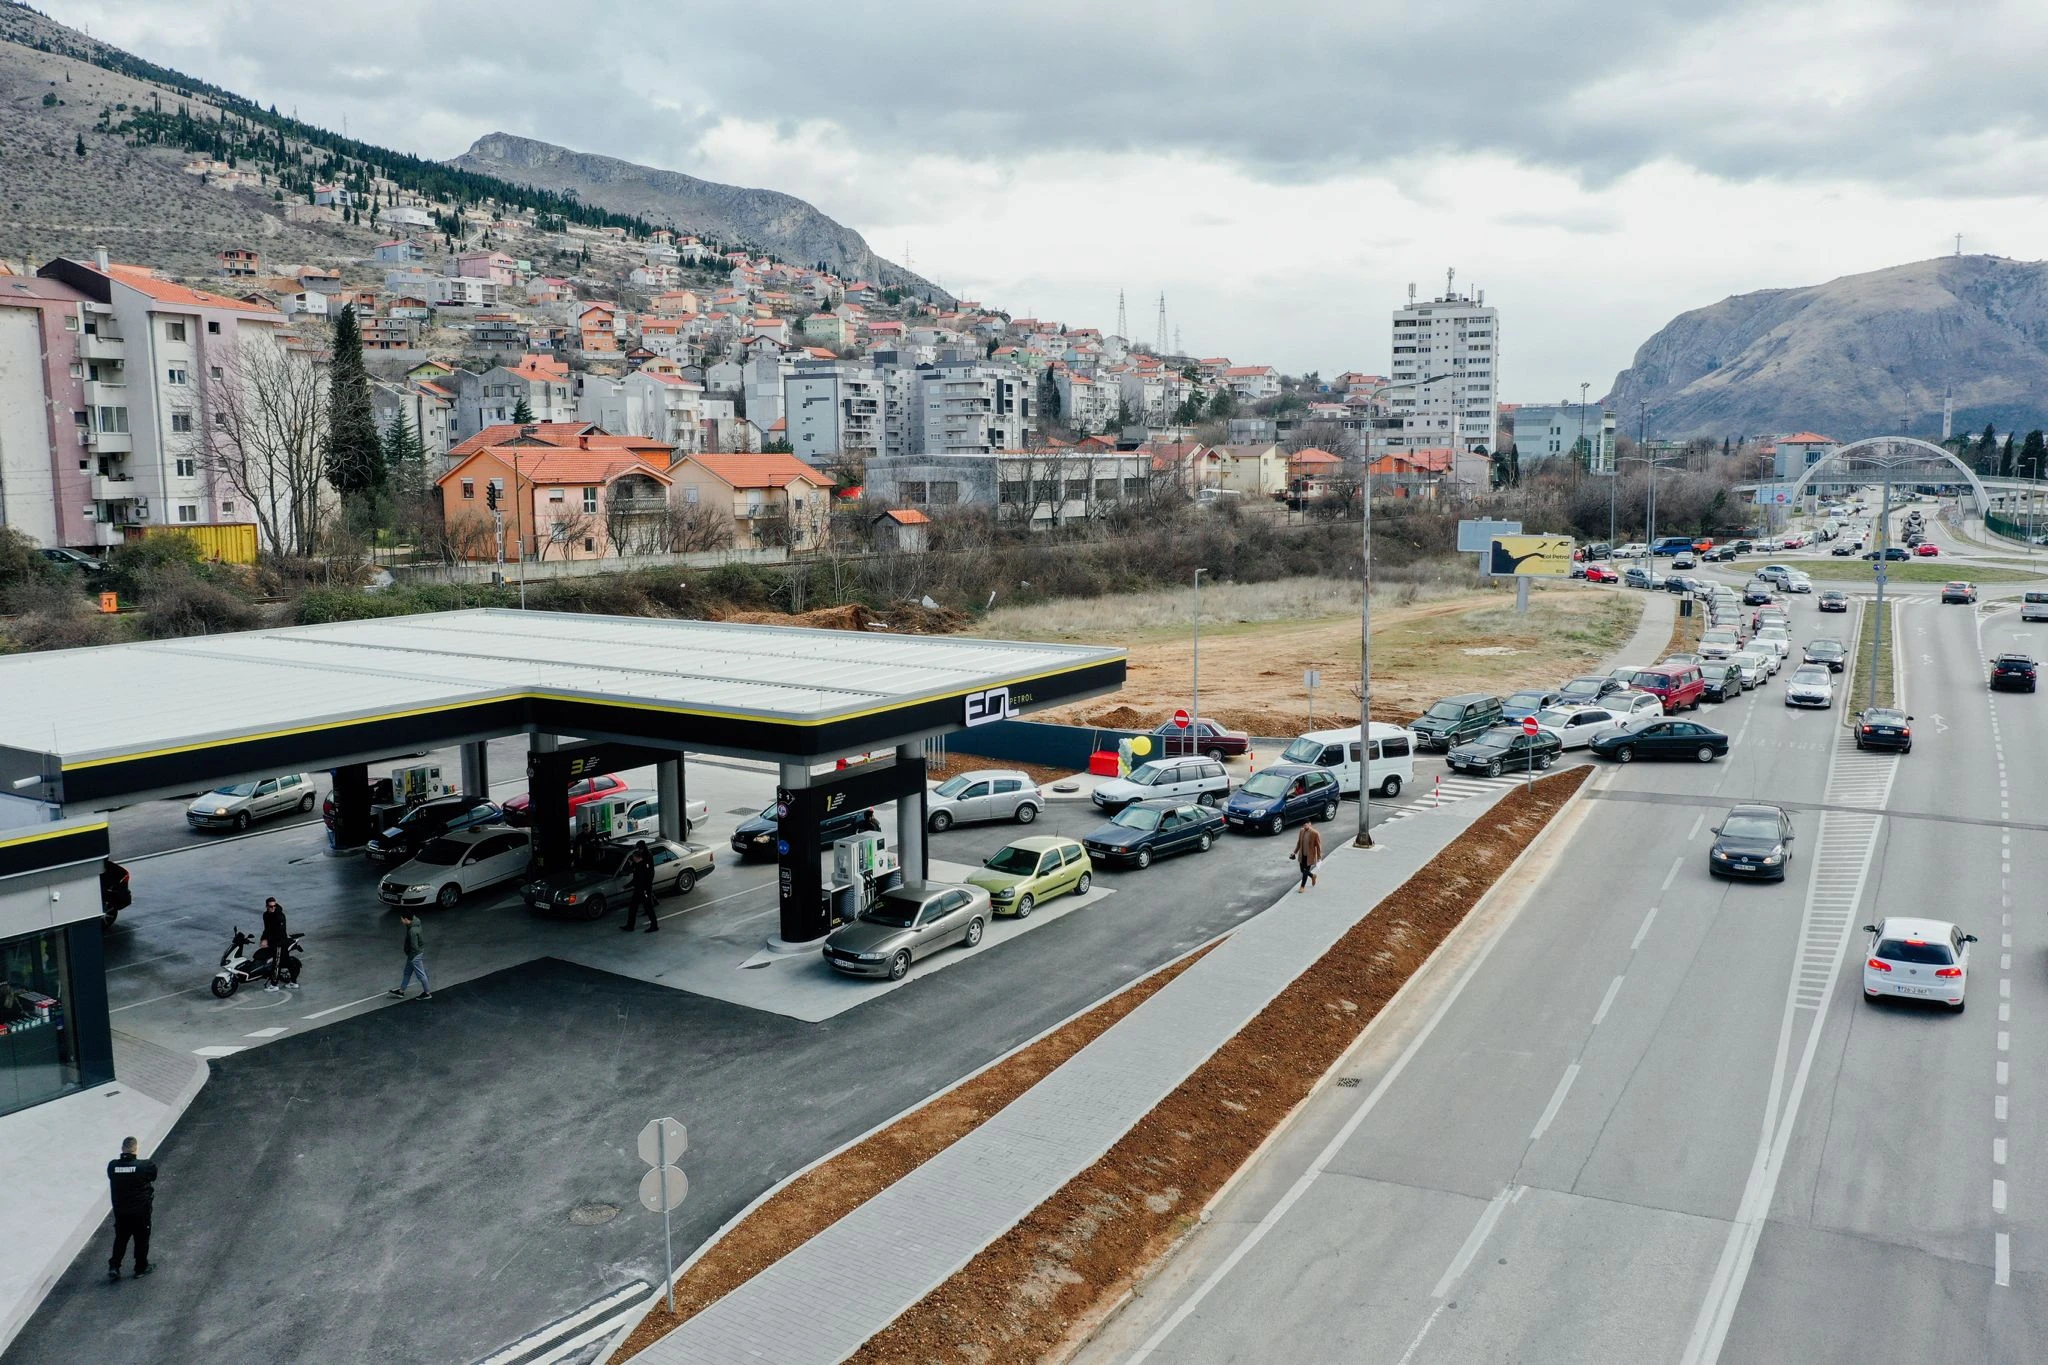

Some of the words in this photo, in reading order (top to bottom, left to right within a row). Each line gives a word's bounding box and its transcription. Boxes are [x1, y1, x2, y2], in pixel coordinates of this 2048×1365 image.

[965, 686, 1020, 728] EOL
[1009, 693, 1033, 705] PETROL
[571, 759, 584, 775] 3
[827, 795, 832, 812] 1
